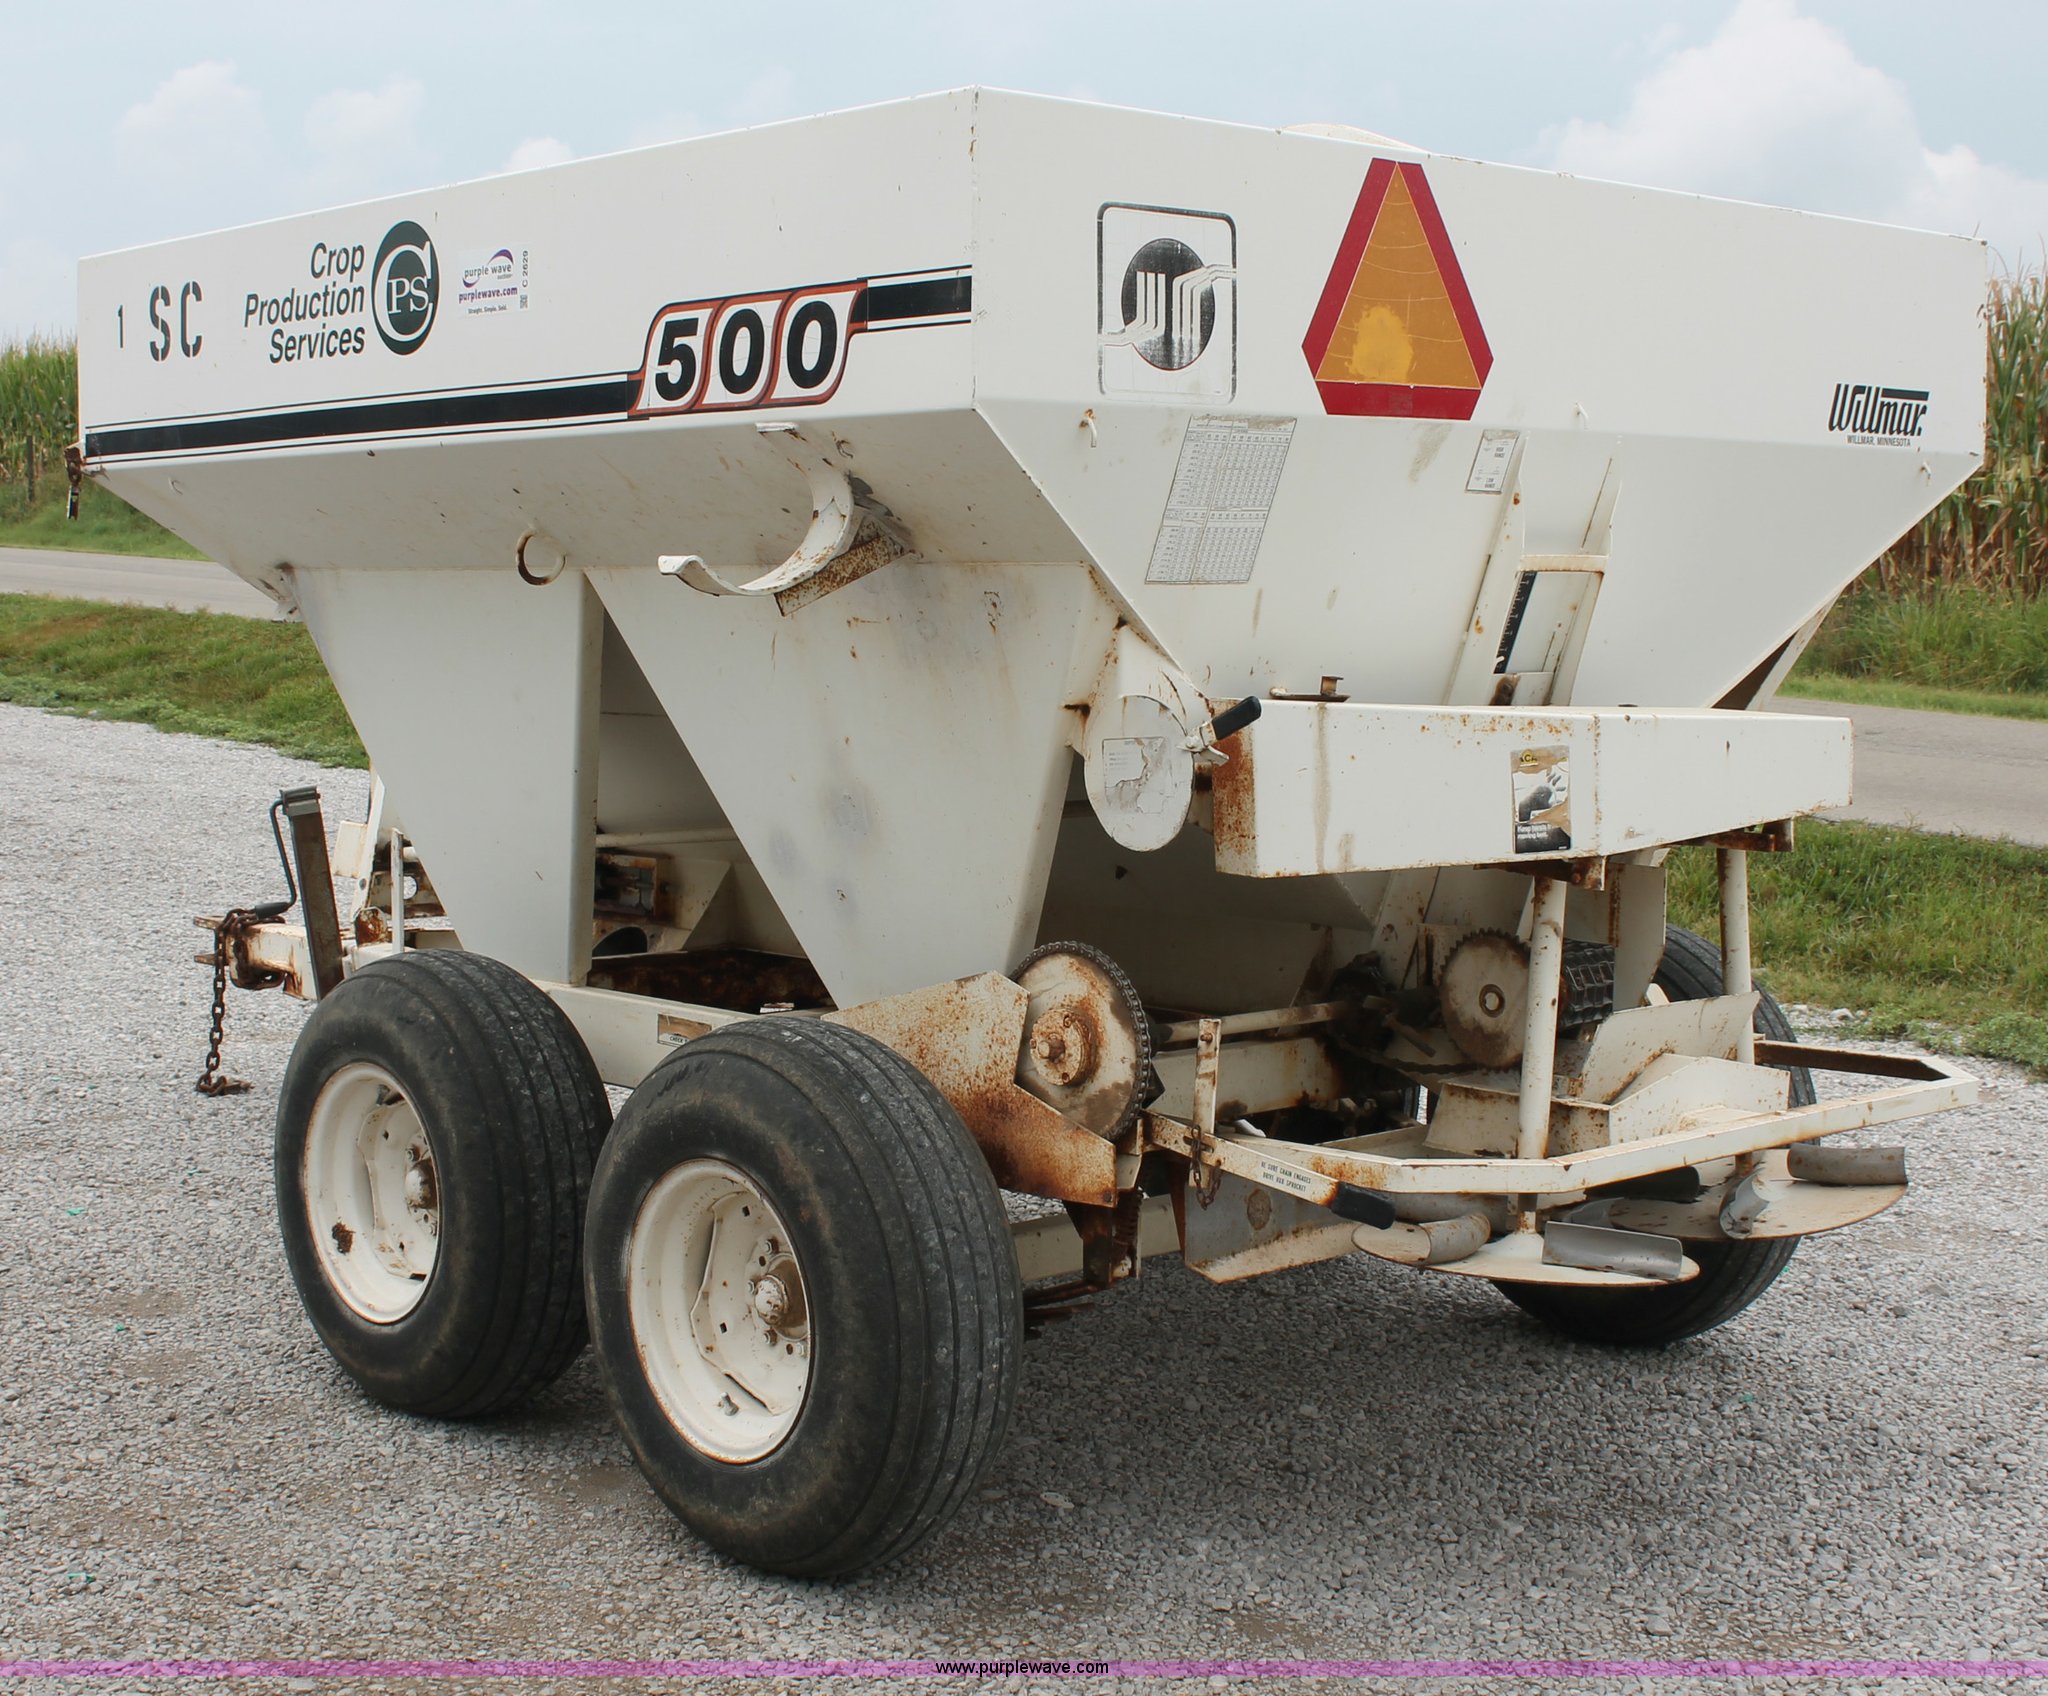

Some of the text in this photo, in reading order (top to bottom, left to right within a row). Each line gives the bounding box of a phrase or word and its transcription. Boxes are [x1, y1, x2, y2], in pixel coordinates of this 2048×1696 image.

[310, 242, 365, 283] Crop
[464, 263, 512, 279] purple wave
[244, 281, 365, 328] Production
[458, 287, 518, 304] purplewave.com
[149, 280, 203, 362] SC
[269, 323, 366, 364] Services
[654, 300, 838, 402] 500
[1877, 436, 1911, 447] MINNESOTA
